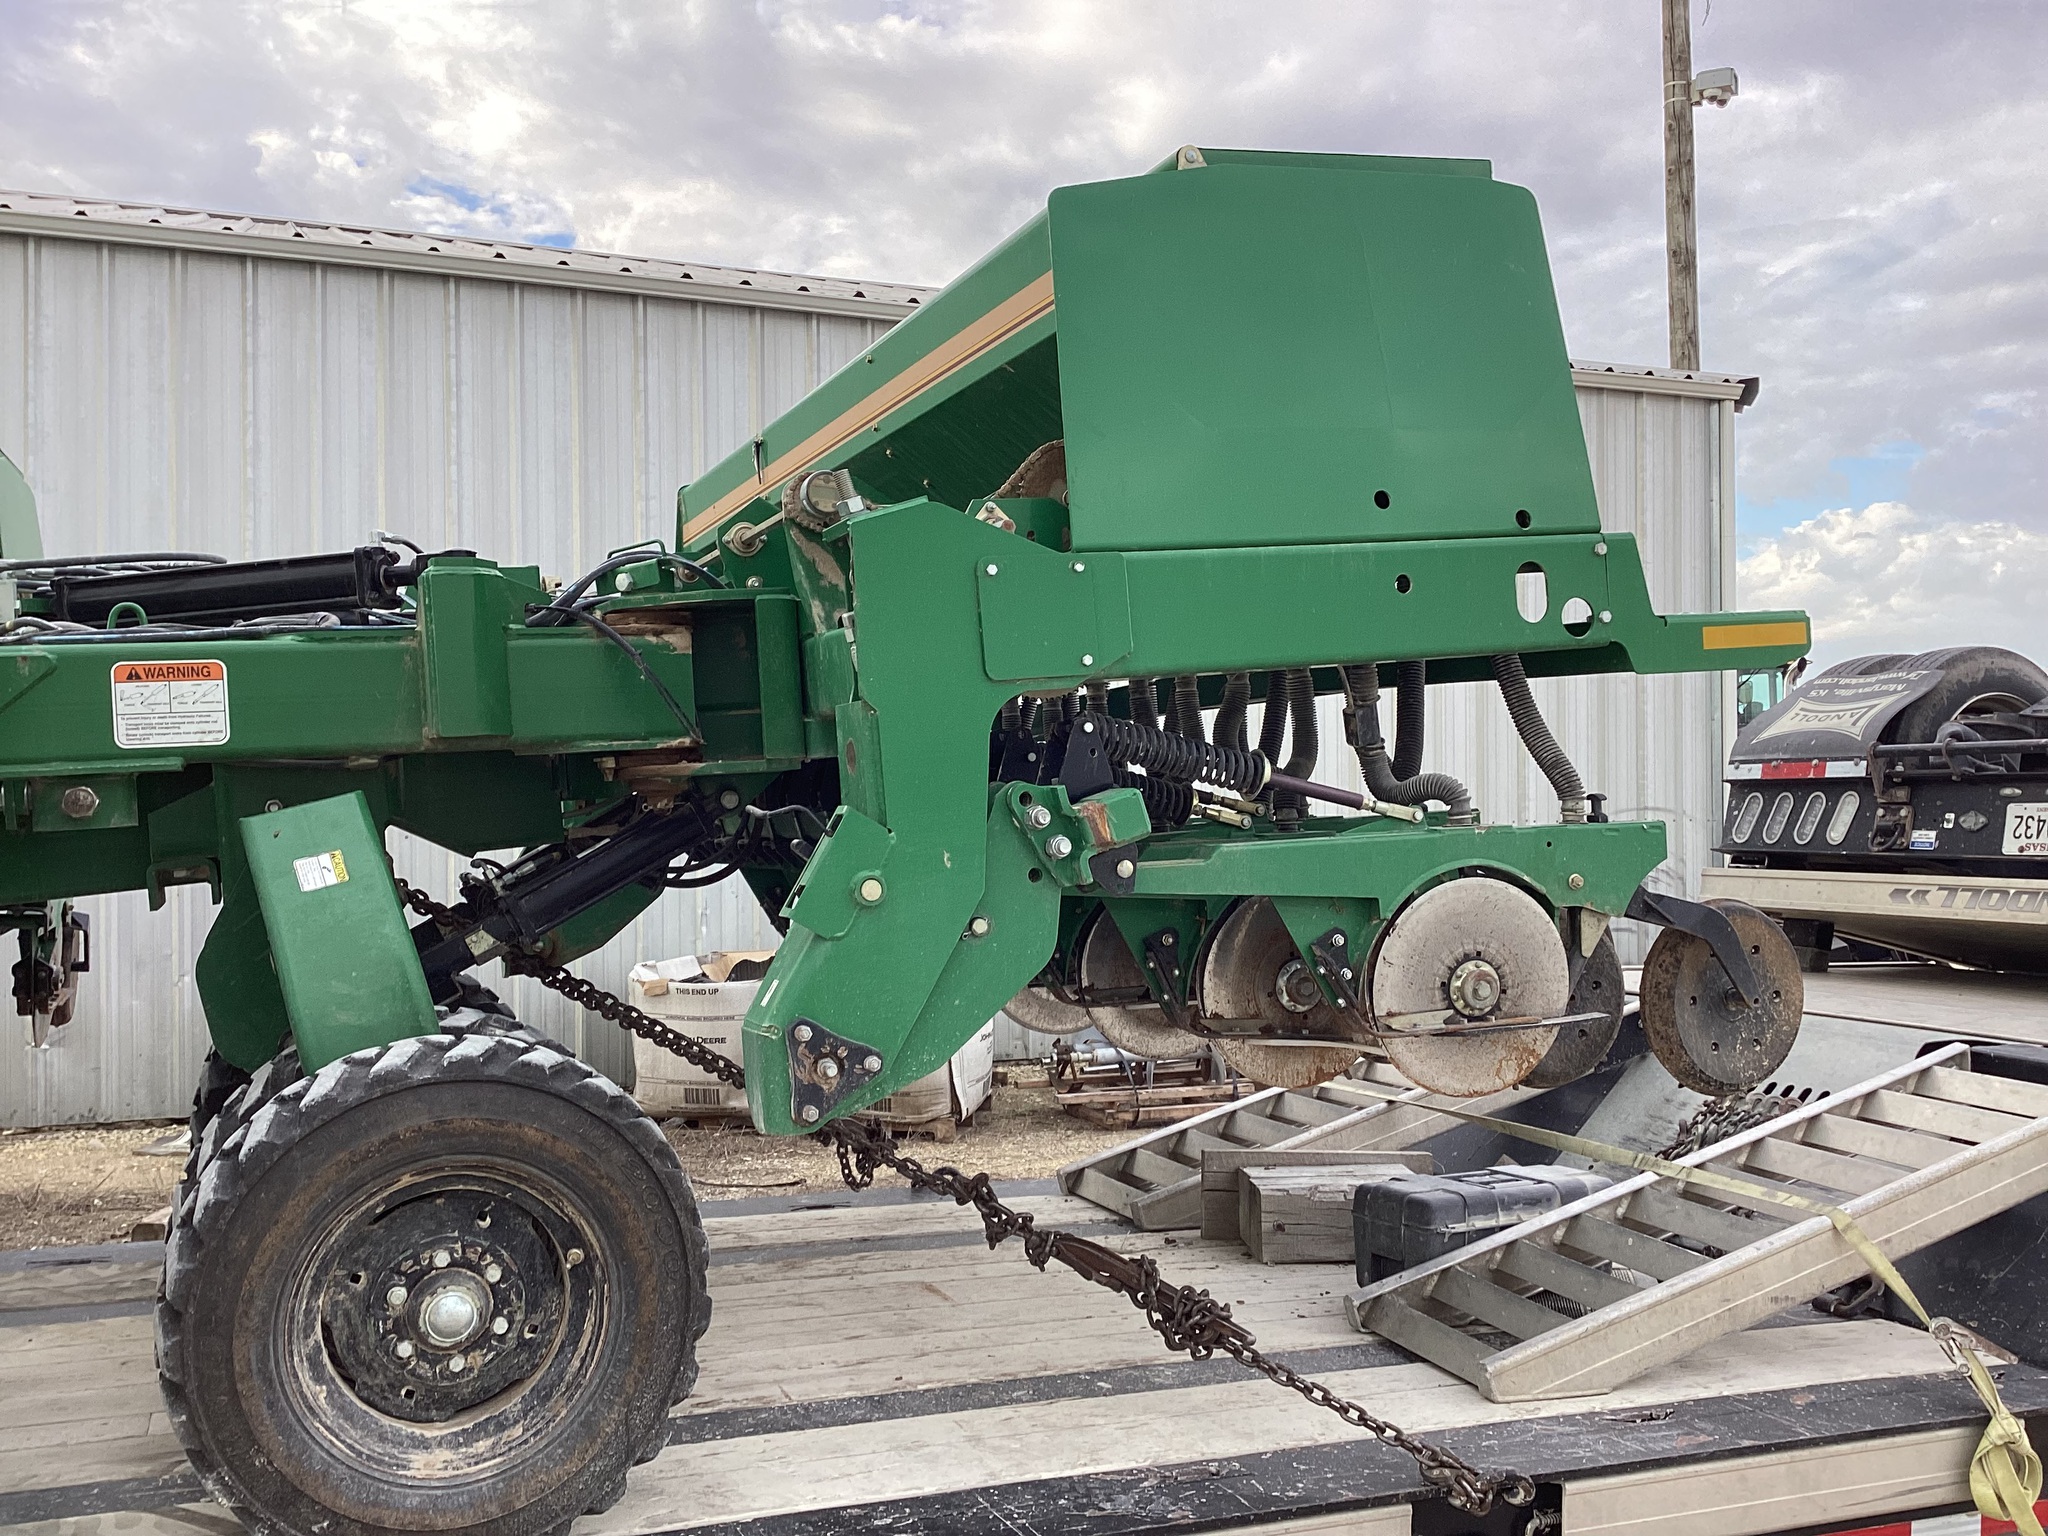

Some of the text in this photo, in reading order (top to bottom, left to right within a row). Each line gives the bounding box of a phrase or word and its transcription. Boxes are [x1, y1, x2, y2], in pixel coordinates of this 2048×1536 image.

[143, 665, 211, 679] WARNING
[1806, 689, 1829, 697] KS
[1790, 702, 1881, 727] LANDOLL
[2013, 815, 2048, 840] 432
[697, 1036, 727, 1044] DEERE
